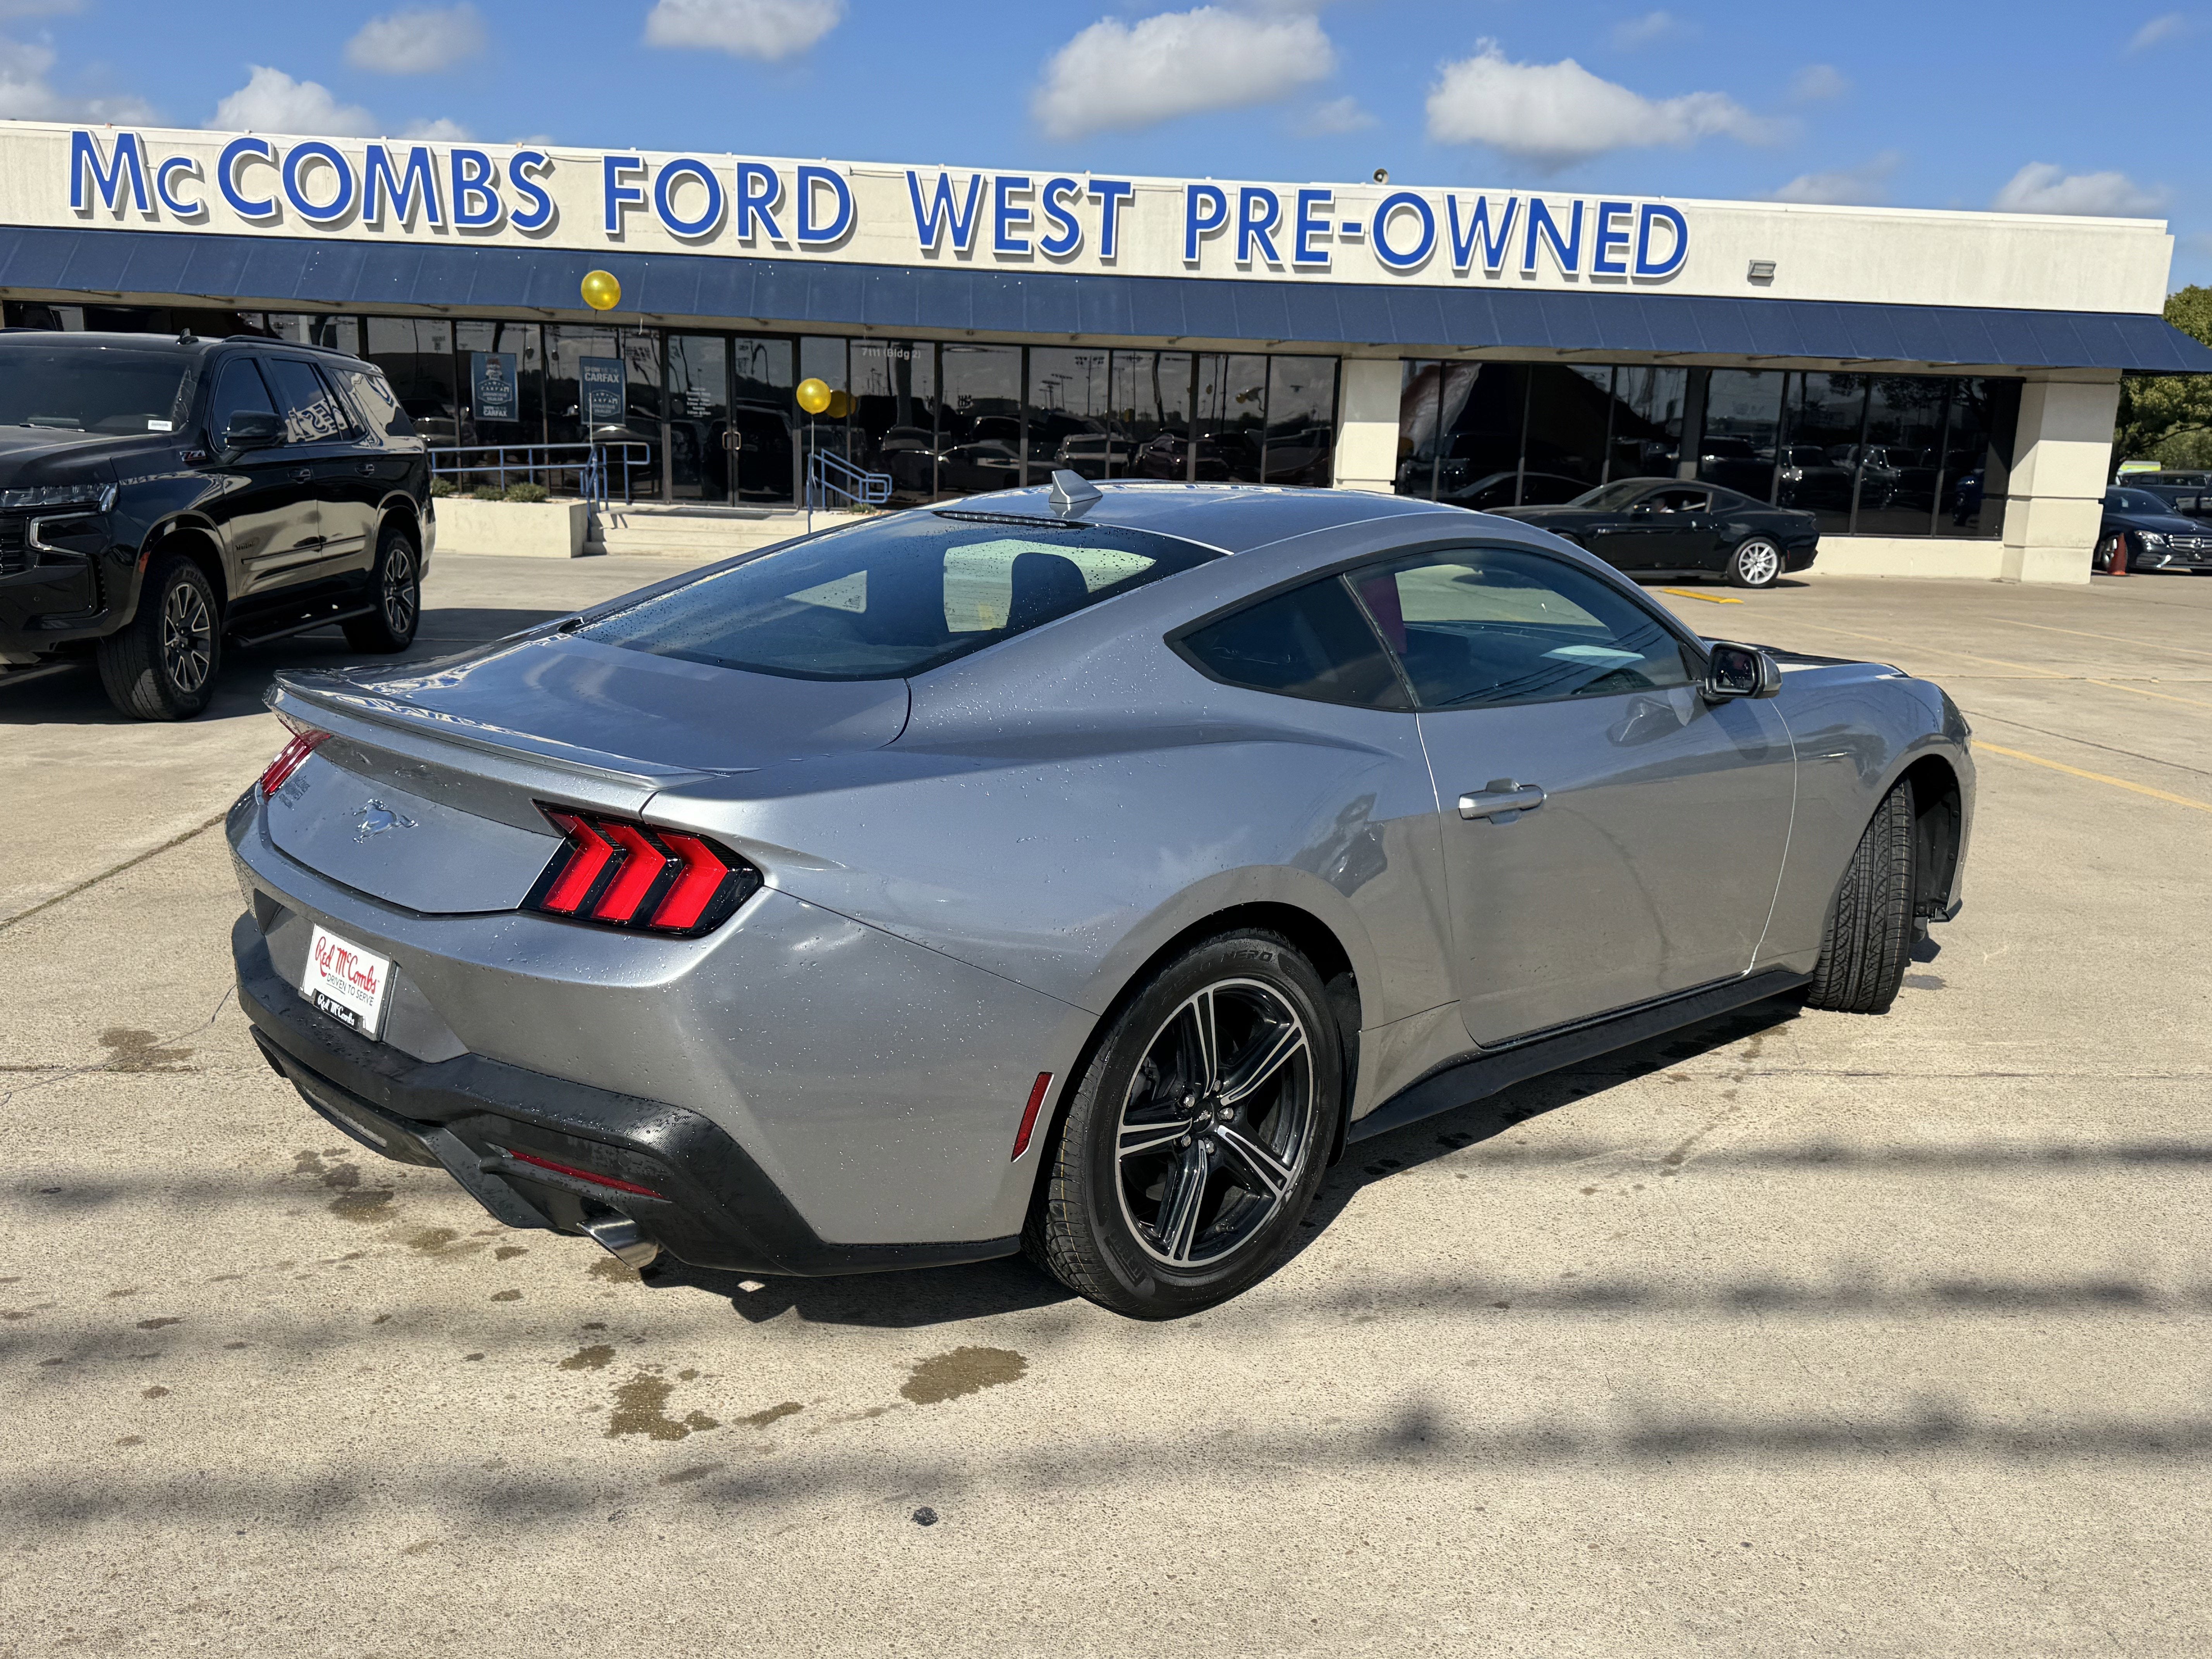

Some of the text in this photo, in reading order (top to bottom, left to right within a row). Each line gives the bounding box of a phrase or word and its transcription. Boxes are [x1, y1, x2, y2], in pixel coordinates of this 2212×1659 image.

[70, 129, 1689, 280] McCOMBS FORD WEST PRE-OWNED
[862, 347, 921, 361] 7111 (Bldg 2)
[585, 373, 619, 383] CARFAX
[315, 936, 376, 994] Red McCombs
[326, 973, 374, 1006] DRIVEN TO SERVE
